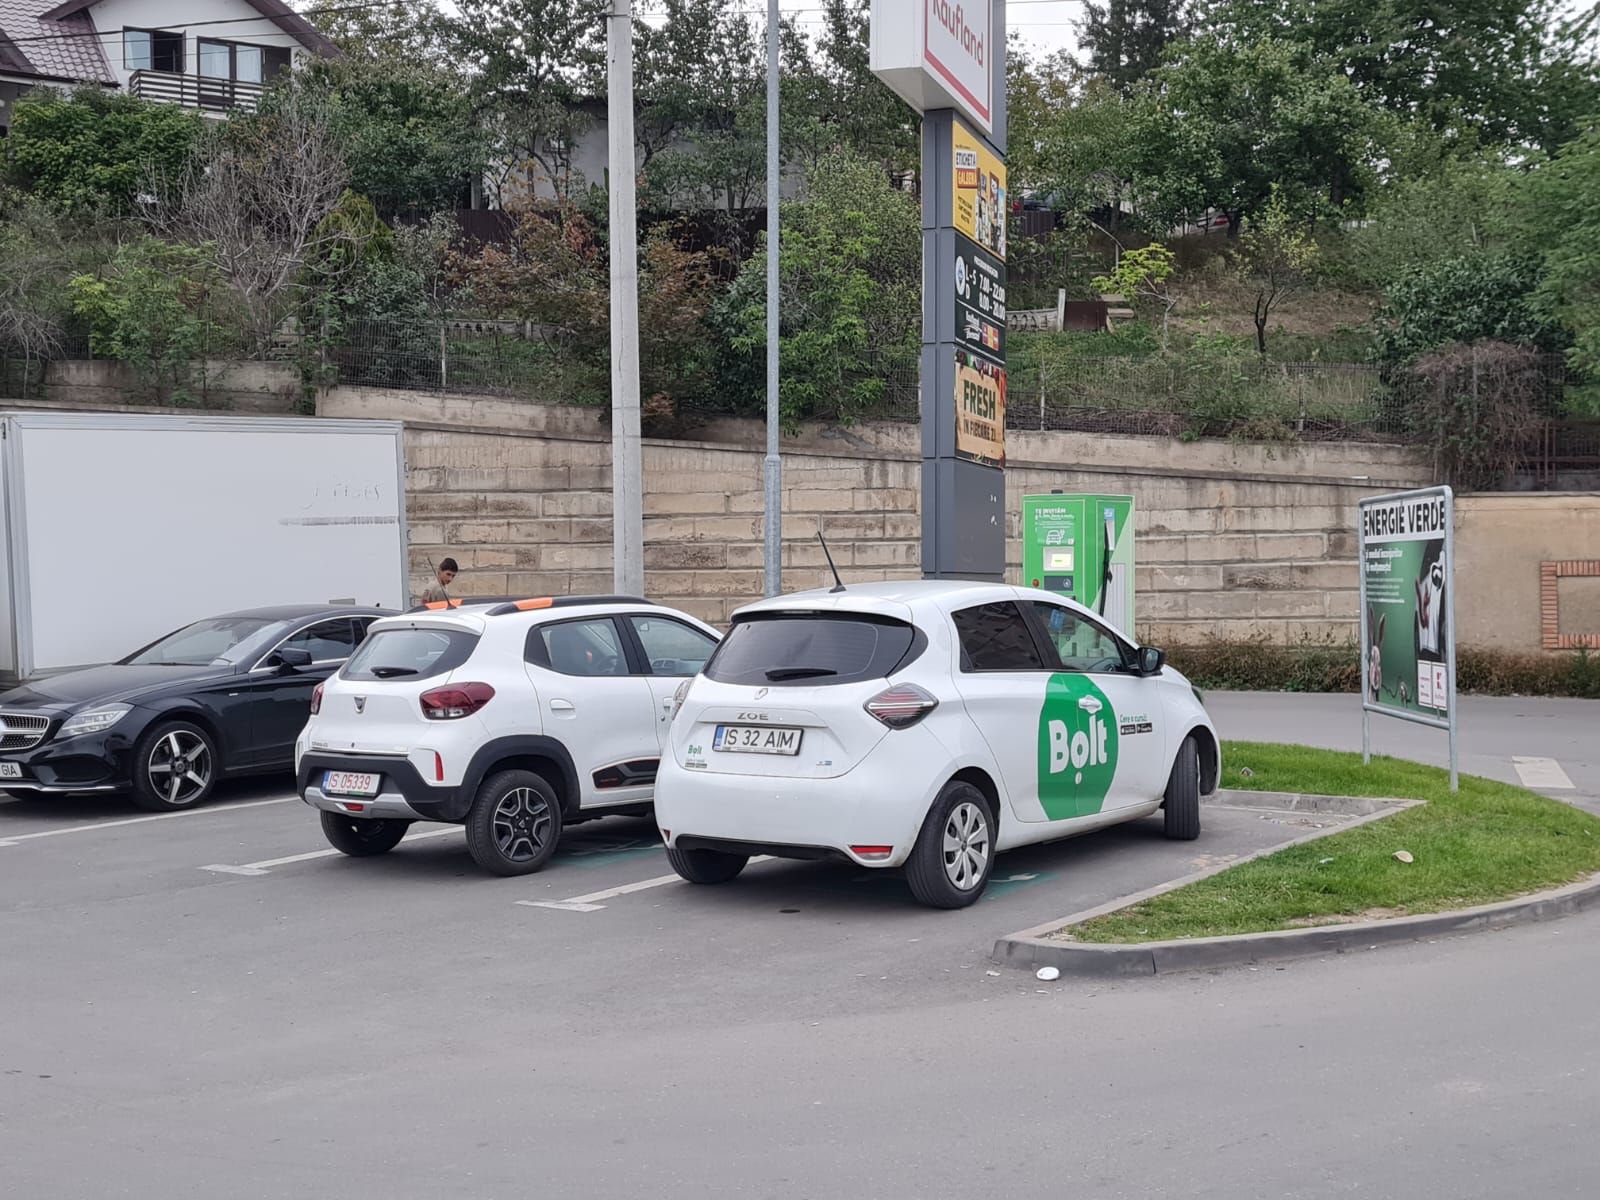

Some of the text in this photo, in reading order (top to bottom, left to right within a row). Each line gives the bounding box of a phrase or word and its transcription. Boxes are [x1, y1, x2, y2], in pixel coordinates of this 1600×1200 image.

[965, 282, 971, 300] D
[963, 379, 996, 421] FRESH
[969, 420, 990, 442] FIECARE
[990, 427, 996, 442] ZI
[1364, 501, 1445, 537] ENERGIE VERDE
[737, 712, 769, 721] ZOE
[723, 729, 794, 749] IS 32 AIM
[1048, 714, 1108, 774] Bolt
[687, 744, 703, 755] Bolt
[1, 764, 17, 776] GIA
[328, 773, 371, 790] IS 05339
